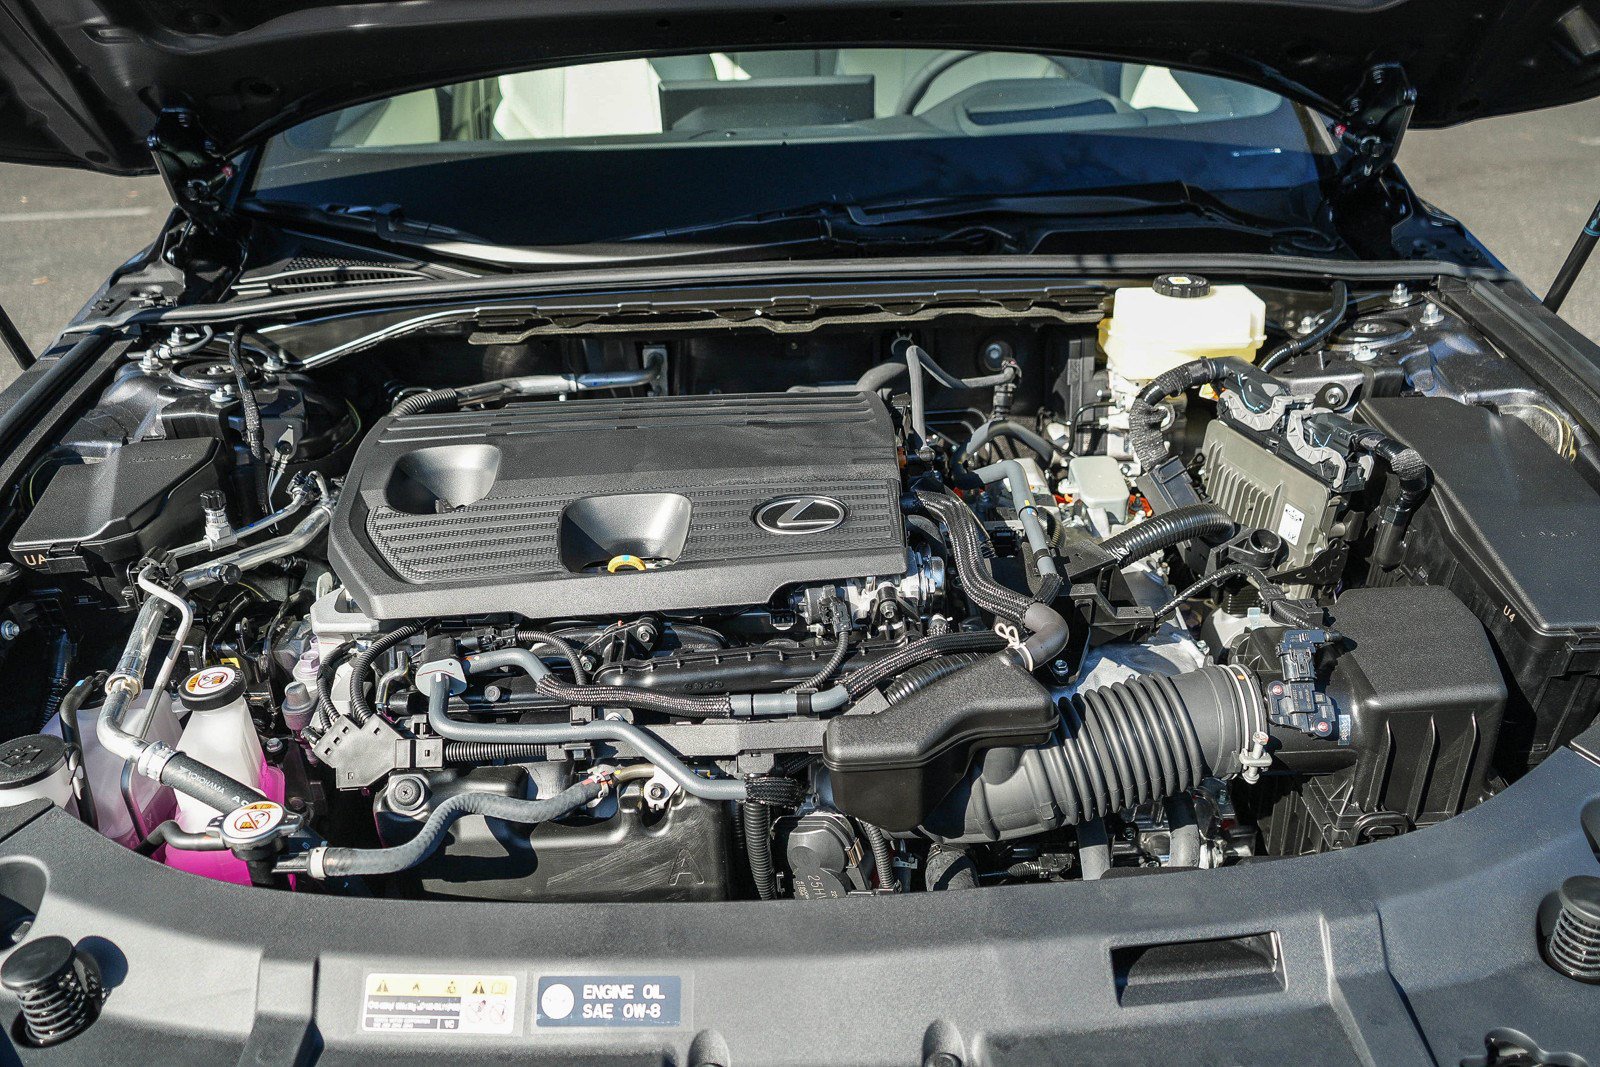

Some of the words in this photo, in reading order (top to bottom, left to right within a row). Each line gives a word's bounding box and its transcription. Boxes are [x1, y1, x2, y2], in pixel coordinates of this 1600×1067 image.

[24, 554, 47, 565] UA
[1504, 605, 1515, 622] U4
[188, 770, 225, 795] YOKOHAMA
[583, 984, 634, 999] ENGINE
[643, 984, 665, 999] OIL
[583, 1003, 614, 1018] SAE
[623, 1003, 661, 1018] 0W-8
